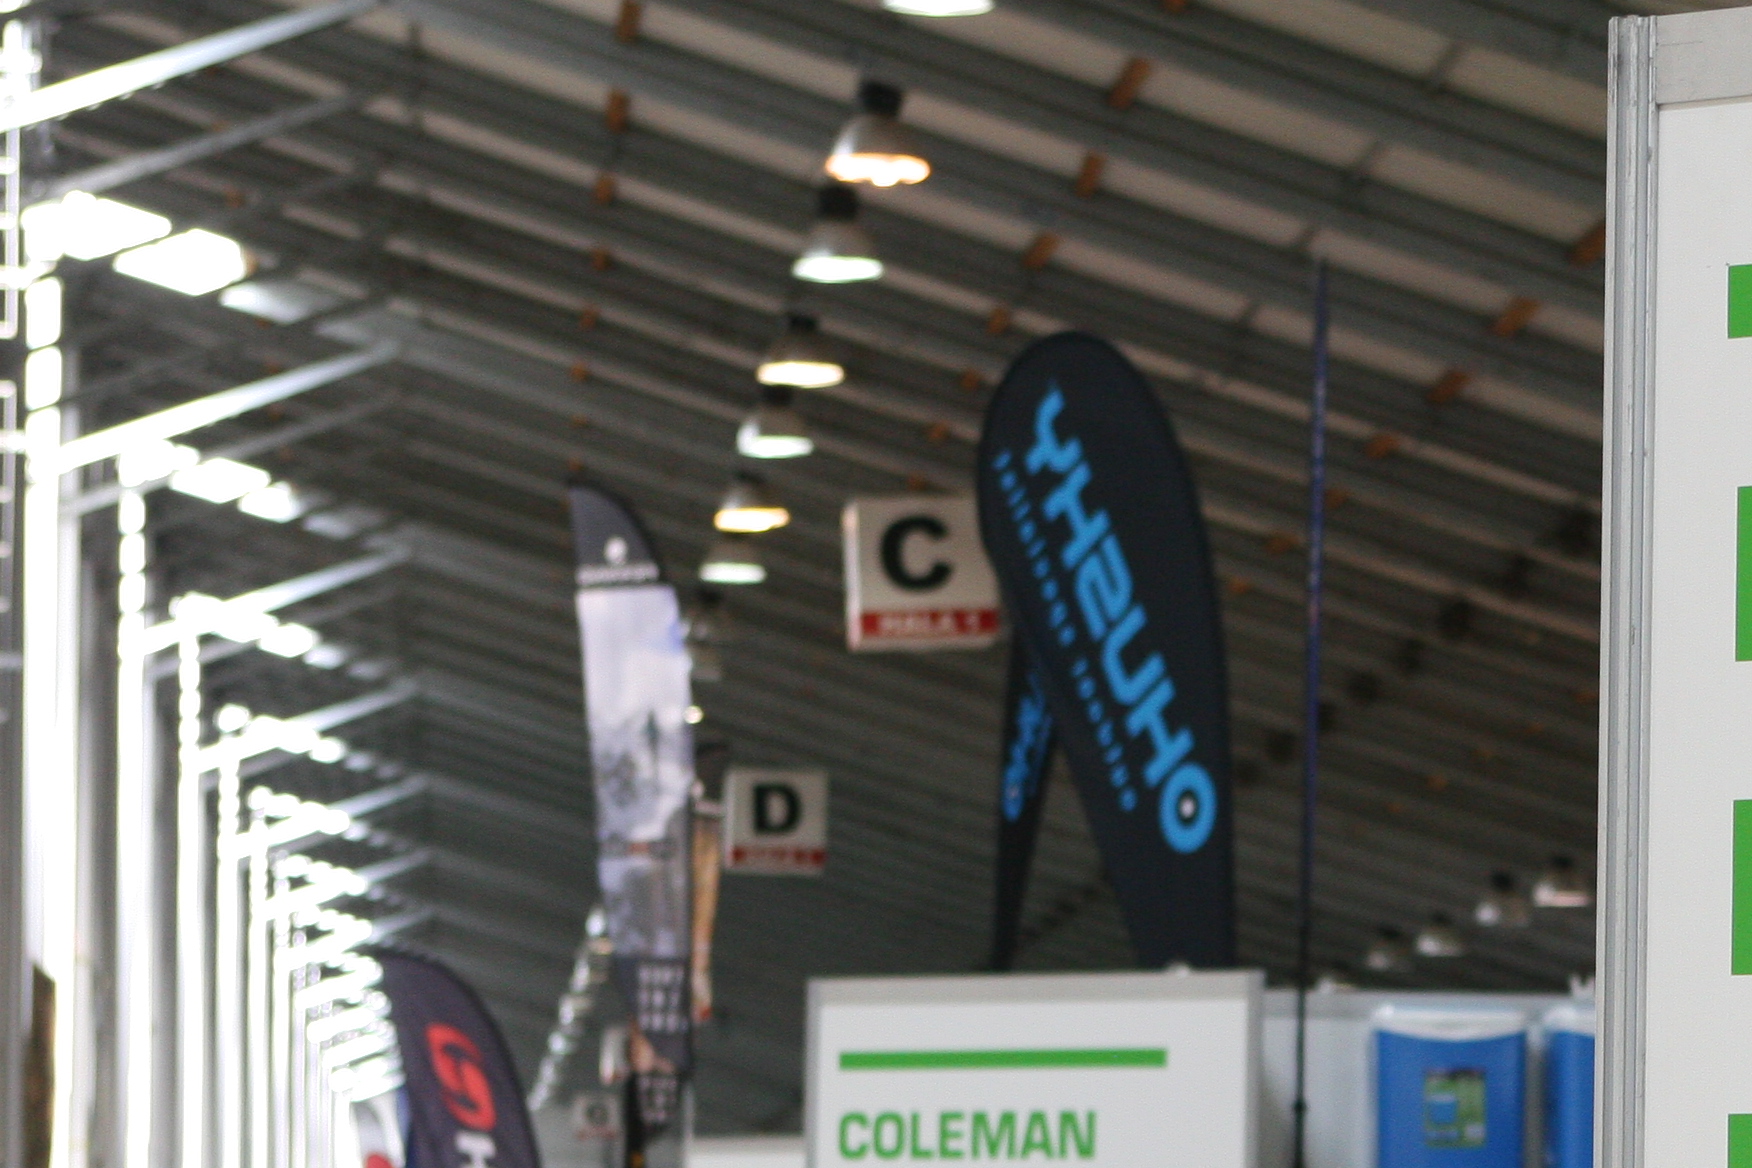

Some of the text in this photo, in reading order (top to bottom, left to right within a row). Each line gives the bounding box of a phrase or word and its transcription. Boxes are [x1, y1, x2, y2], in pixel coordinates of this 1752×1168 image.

[880, 515, 951, 592] C
[752, 783, 803, 834] D
[838, 1111, 1097, 1160] COLEMAN
